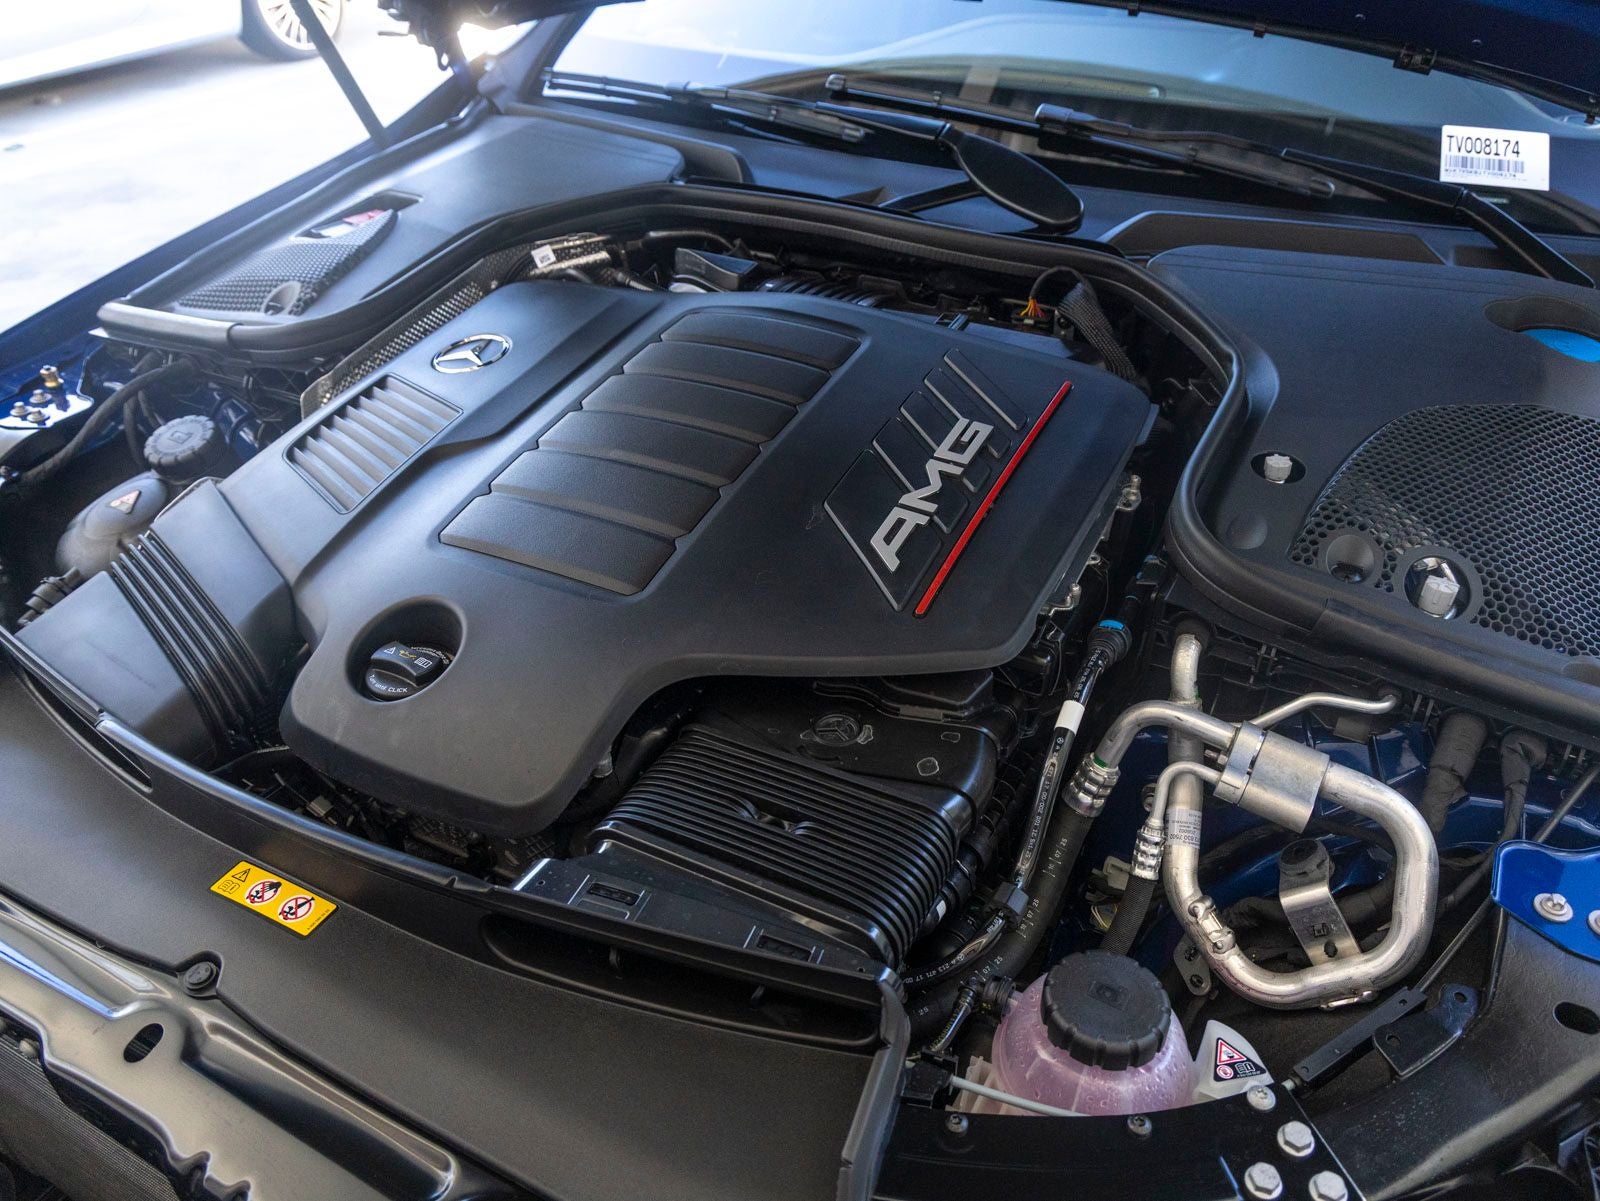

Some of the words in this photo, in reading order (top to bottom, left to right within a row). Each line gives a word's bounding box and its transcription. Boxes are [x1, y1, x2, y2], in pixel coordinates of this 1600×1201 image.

[1446, 135, 1520, 157] TV008174
[870, 417, 994, 574] AMG
[994, 955, 1004, 965] 25
